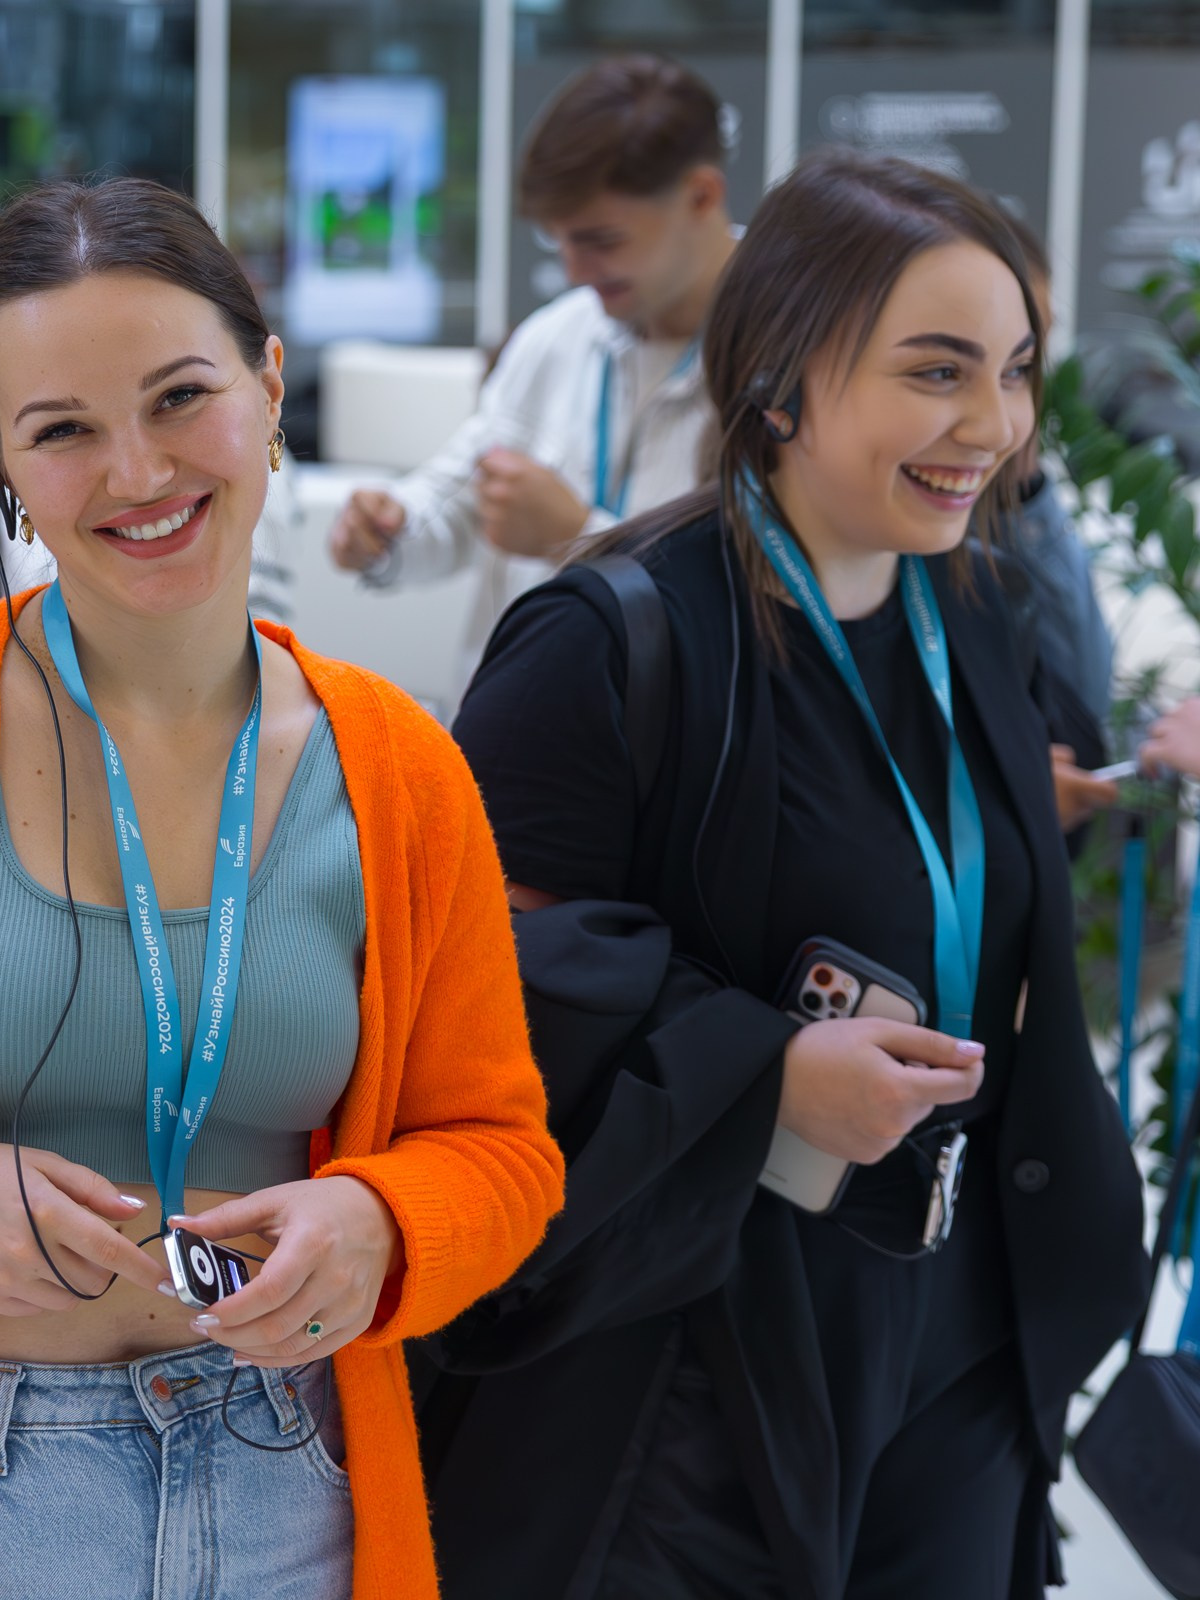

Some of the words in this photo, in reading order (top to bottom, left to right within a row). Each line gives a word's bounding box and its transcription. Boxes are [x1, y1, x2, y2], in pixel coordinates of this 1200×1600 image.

[116, 806, 130, 852] Евразия
[233, 824, 246, 868] Евразия
[134, 883, 173, 1054] #УзнайРоссию2024
[201, 896, 236, 1063] #УзнайРоссию2024
[153, 1087, 164, 1133] Евразия
[184, 1096, 208, 1140] Евразия
